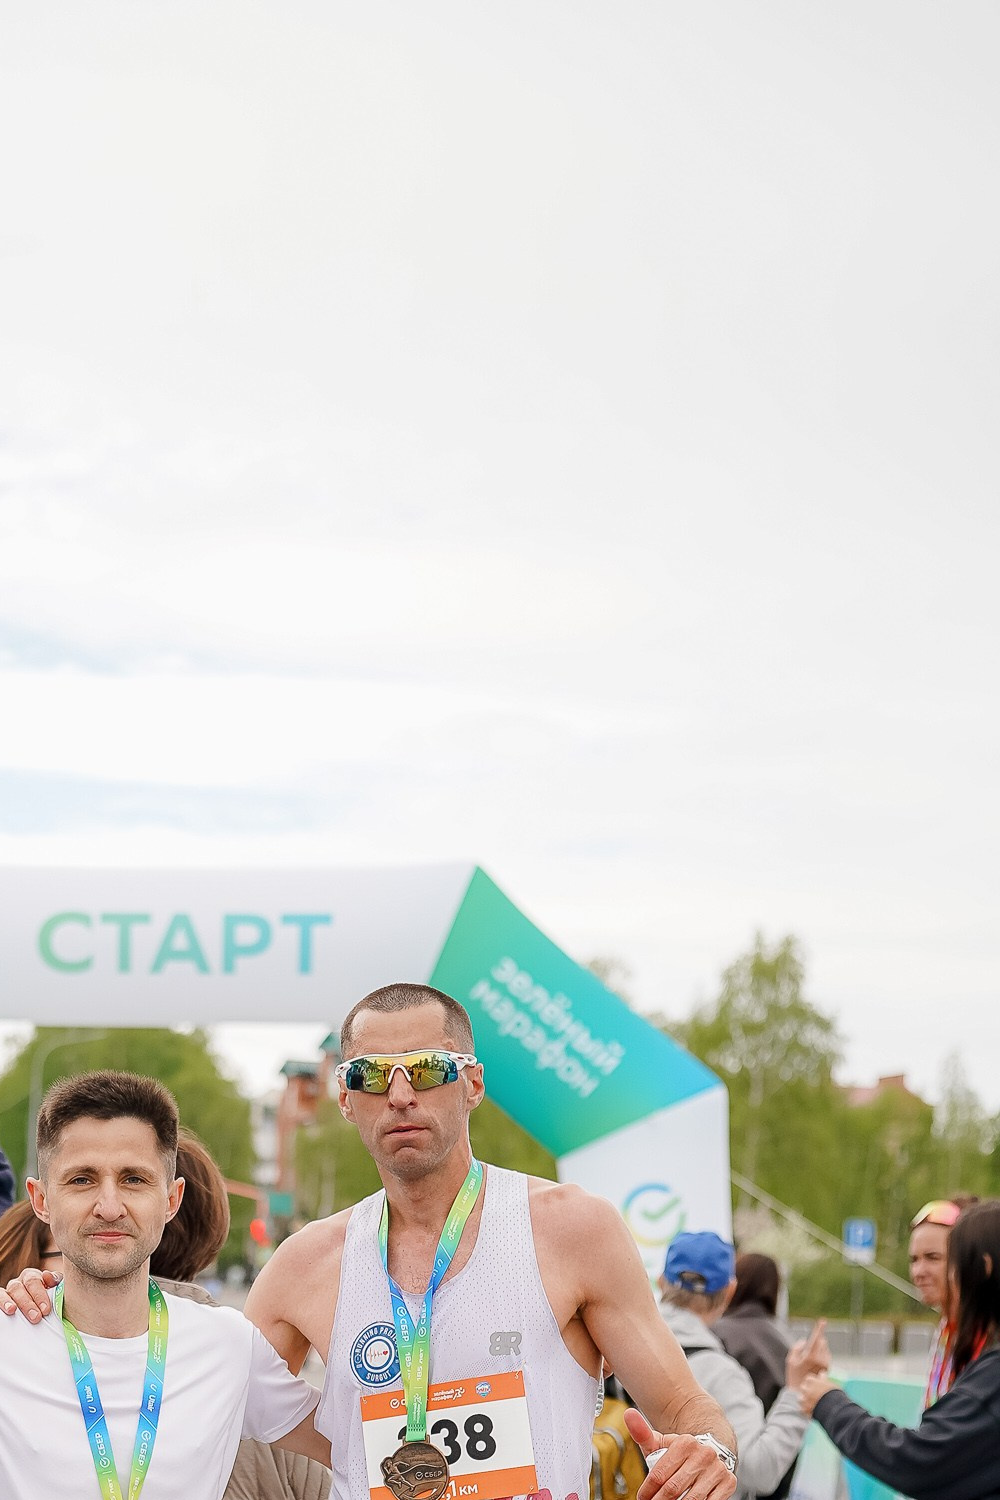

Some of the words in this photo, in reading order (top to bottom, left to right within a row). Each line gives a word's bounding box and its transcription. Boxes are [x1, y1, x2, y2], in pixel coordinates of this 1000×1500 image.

[37, 911, 334, 976] СТАРТ
[491, 956, 627, 1075] зелёный
[469, 976, 599, 1098] марафон
[400, 1319, 410, 1342] СБЕР
[366, 1370, 392, 1382] SURGUT
[84, 1385, 94, 1403] Utair
[148, 1394, 156, 1412] Utair
[95, 1432, 106, 1456] СБЕР
[138, 1443, 148, 1466] СБЕР
[424, 1470, 443, 1478] СБЕР
[459, 1485, 479, 1497] км
